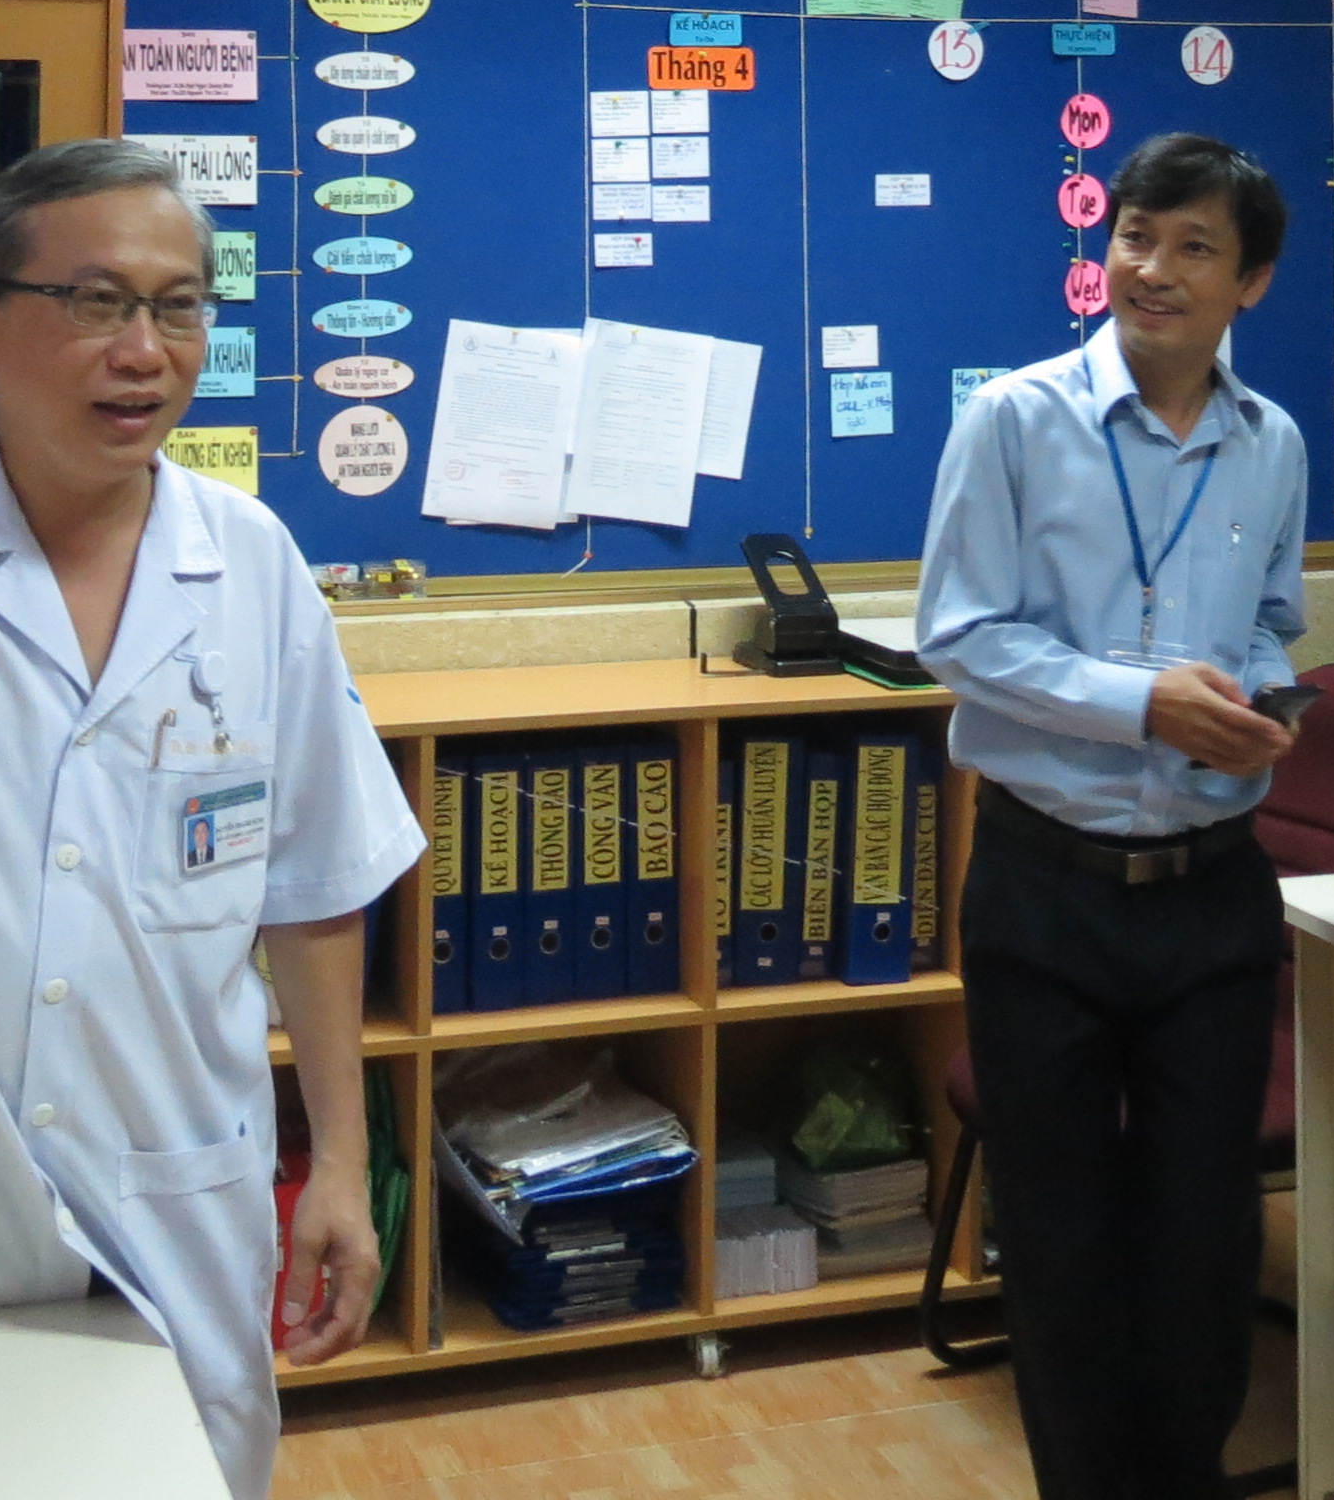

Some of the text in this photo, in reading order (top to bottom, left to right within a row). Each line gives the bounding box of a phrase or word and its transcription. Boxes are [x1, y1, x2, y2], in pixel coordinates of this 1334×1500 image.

[675, 17, 734, 33] KẾ HOẠCH
[1055, 28, 1111, 43] THỰC HIỆN
[139, 37, 174, 72] TOÀN
[176, 37, 217, 72] NGƯỜI
[221, 42, 254, 79] BỆNH
[652, 49, 749, 87] Tháng 4
[1183, 35, 1228, 79] 14
[1069, 104, 1102, 137] Mon
[190, 143, 212, 181] HÀI
[216, 144, 253, 182] LÒNG
[1067, 182, 1097, 216] Tue
[1070, 269, 1102, 302] Wed
[748, 746, 783, 794] LUYỆN
[859, 748, 894, 786] ĐỒNG
[639, 762, 667, 874] BÁO CÁO
[746, 798, 774, 840] HUẤN
[864, 788, 899, 812] HỘI
[485, 773, 514, 888] KẾ HOẠCH
[536, 771, 565, 885] THÔNG BÁO
[587, 767, 616, 879] CÔNG VĂN
[856, 816, 891, 842] CÁC
[806, 782, 836, 938] BIÊN BẢN HỌP
[745, 878, 772, 908] CÁC
